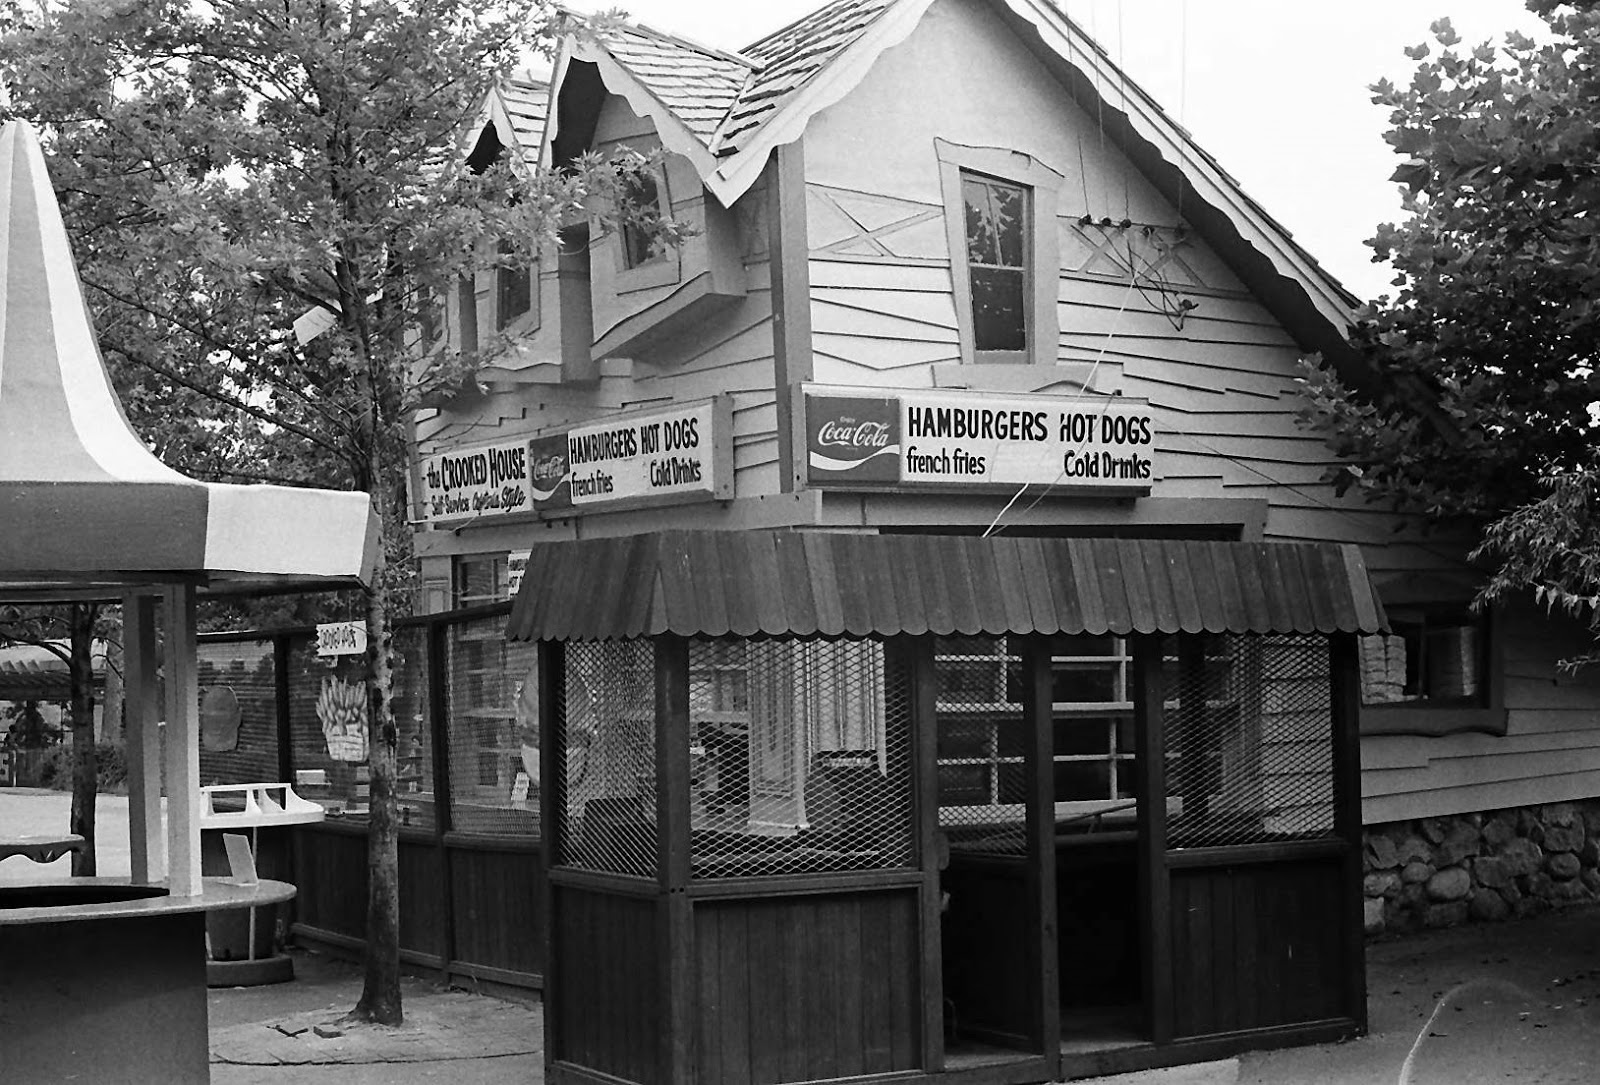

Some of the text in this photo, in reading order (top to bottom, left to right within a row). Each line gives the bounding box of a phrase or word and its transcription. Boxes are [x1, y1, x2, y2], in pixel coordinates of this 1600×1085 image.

[570, 417, 699, 465] HAMBURGERS HOT DOGS
[908, 407, 1151, 445] HAMBURGERS HOT DOGS
[426, 447, 526, 492] the CROOKED HOUSE
[650, 456, 701, 487] Cold Drinks
[907, 446, 985, 475] french fries
[1064, 450, 1152, 479] Cold Drinks
[500, 485, 526, 512] Style
[571, 469, 613, 498] french fries
